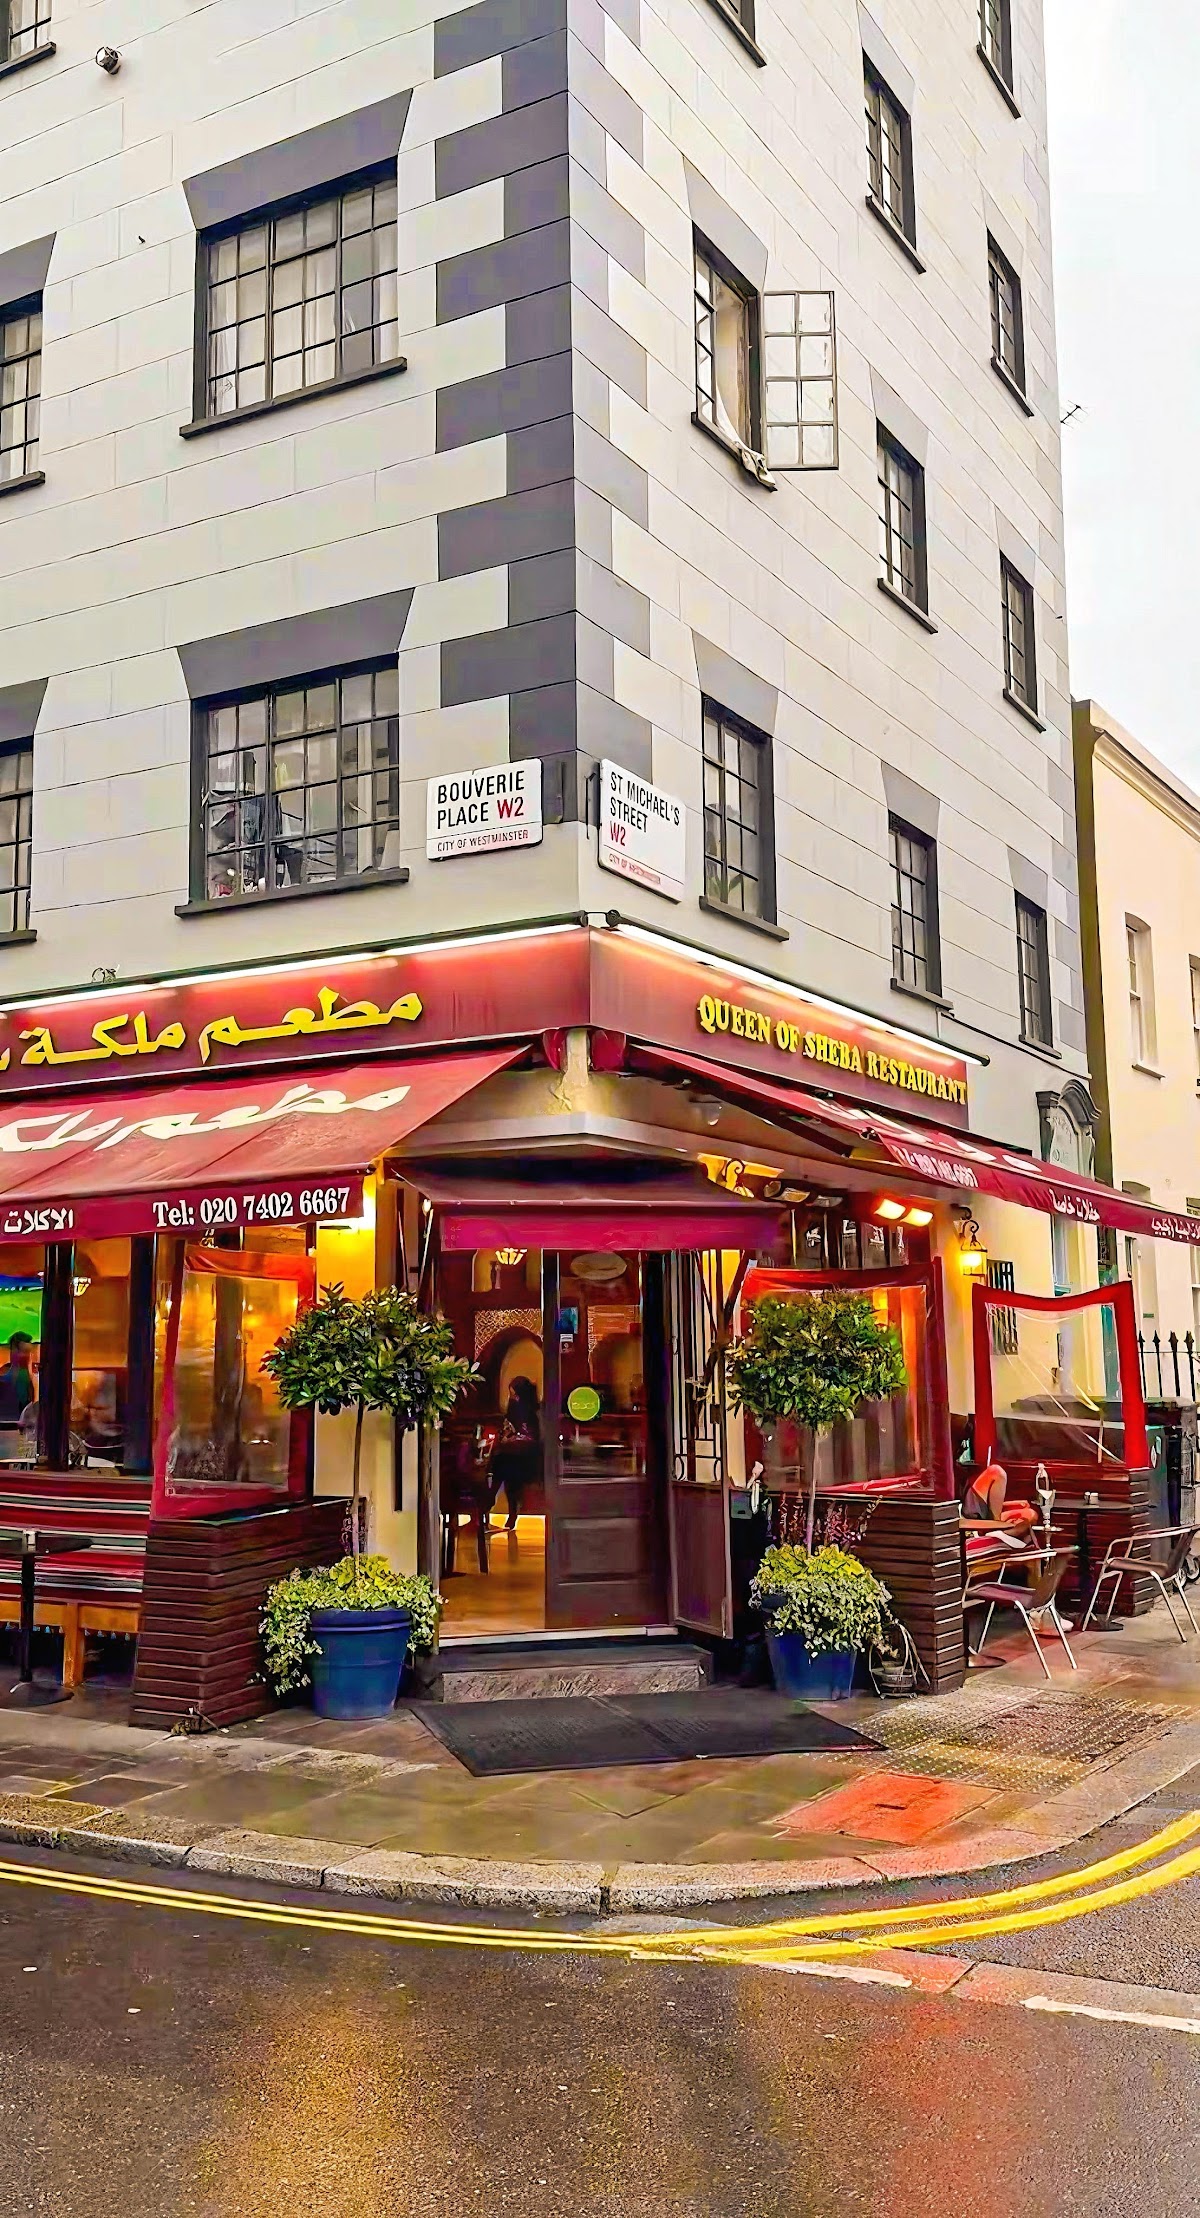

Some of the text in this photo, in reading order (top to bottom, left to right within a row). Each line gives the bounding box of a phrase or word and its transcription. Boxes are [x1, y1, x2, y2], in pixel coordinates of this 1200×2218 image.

[438, 770, 525, 804] BOUVERIE
[610, 771, 680, 826] ST MICHAEL'S
[437, 796, 525, 829] PLACE W2
[610, 796, 648, 833] STREET
[437, 829, 529, 852] CITY OF WESTMINSTER
[609, 820, 626, 847] W2
[18, 985, 423, 1065] مطعم ملكة
[697, 994, 968, 1105] QUEEN OF SHEBA RESTAURANT
[0, 1083, 412, 1152] مطعم ملك
[152, 1187, 350, 1227] Tel: 020 7402 6667
